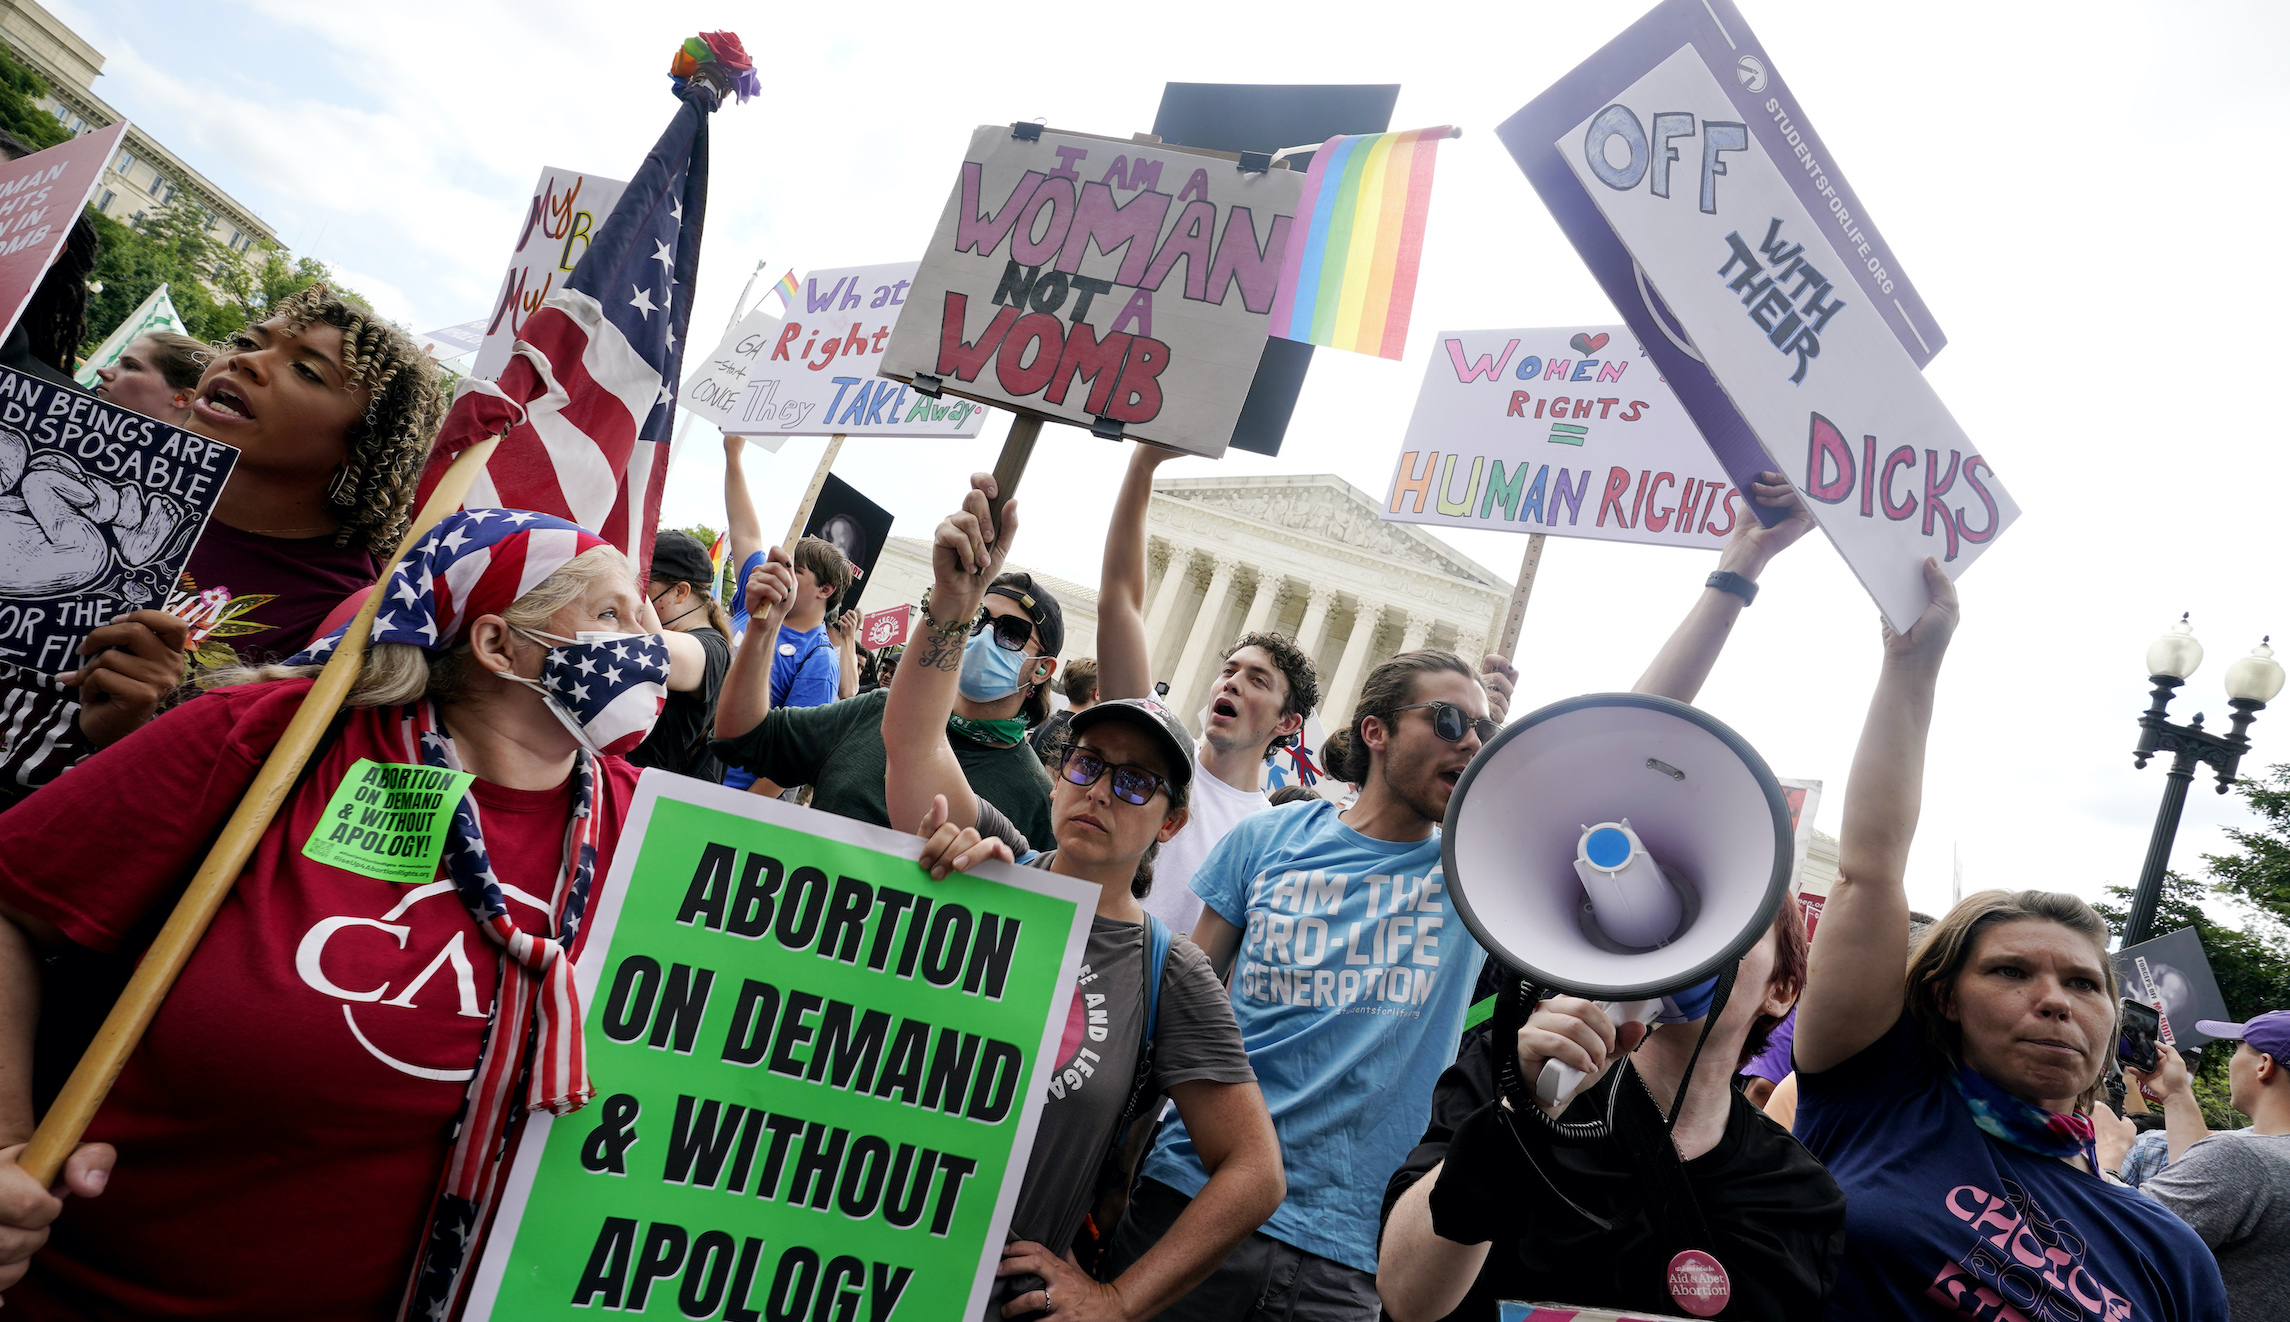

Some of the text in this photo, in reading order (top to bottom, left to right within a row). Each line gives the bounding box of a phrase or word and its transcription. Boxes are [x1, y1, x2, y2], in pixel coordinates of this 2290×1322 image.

[1048, 145, 1209, 201] I AM A
[1584, 104, 1748, 215] OFF
[515, 176, 583, 252] My
[1764, 97, 1895, 295] STUDENTSFORLIFE.ORG
[955, 161, 1297, 315] WOMAN
[807, 276, 910, 314] What
[992, 260, 1153, 337] NOT A
[1758, 216, 1846, 335] WITH
[1716, 230, 1823, 387] THEIR
[935, 290, 1170, 424] WOMB
[691, 378, 741, 414] CONCE
[742, 380, 816, 429] They
[823, 377, 909, 425] TAKE
[1507, 390, 1650, 421] RIGHTS
[3, 401, 213, 505] DISPOSABLE
[47, 392, 156, 446] BEINGS
[160, 432, 226, 472] ARE
[1389, 450, 1741, 537] HUMAN RIGHTS
[1799, 411, 1998, 562] DICKS
[56, 599, 112, 627] THE
[354, 786, 443, 810] ON DEMAND
[361, 767, 457, 791] ABORTION
[329, 822, 432, 857] APOLOGY!
[337, 803, 437, 832] & WITHOUT
[1270, 869, 1349, 916] AM
[1363, 864, 1443, 918] THE
[676, 841, 1022, 1002] ABORTION
[1247, 910, 1444, 967] PRO-LIFE
[1242, 961, 1437, 1007] GENERATION
[601, 954, 1024, 1126] ON DEMAND
[1085, 993, 1108, 1042] AND
[2160, 1017, 2174, 1042] BODY
[1044, 1047, 1101, 1104] LEGA
[580, 1093, 978, 1237] & WITHOUT
[570, 1215, 914, 1322] APOLOGY
[1669, 1273, 1689, 1283] Aid
[1698, 1273, 1724, 1283] Abet
[1945, 1185, 2132, 1322] CHOICE
[1671, 1284, 1727, 1296] Abortion
